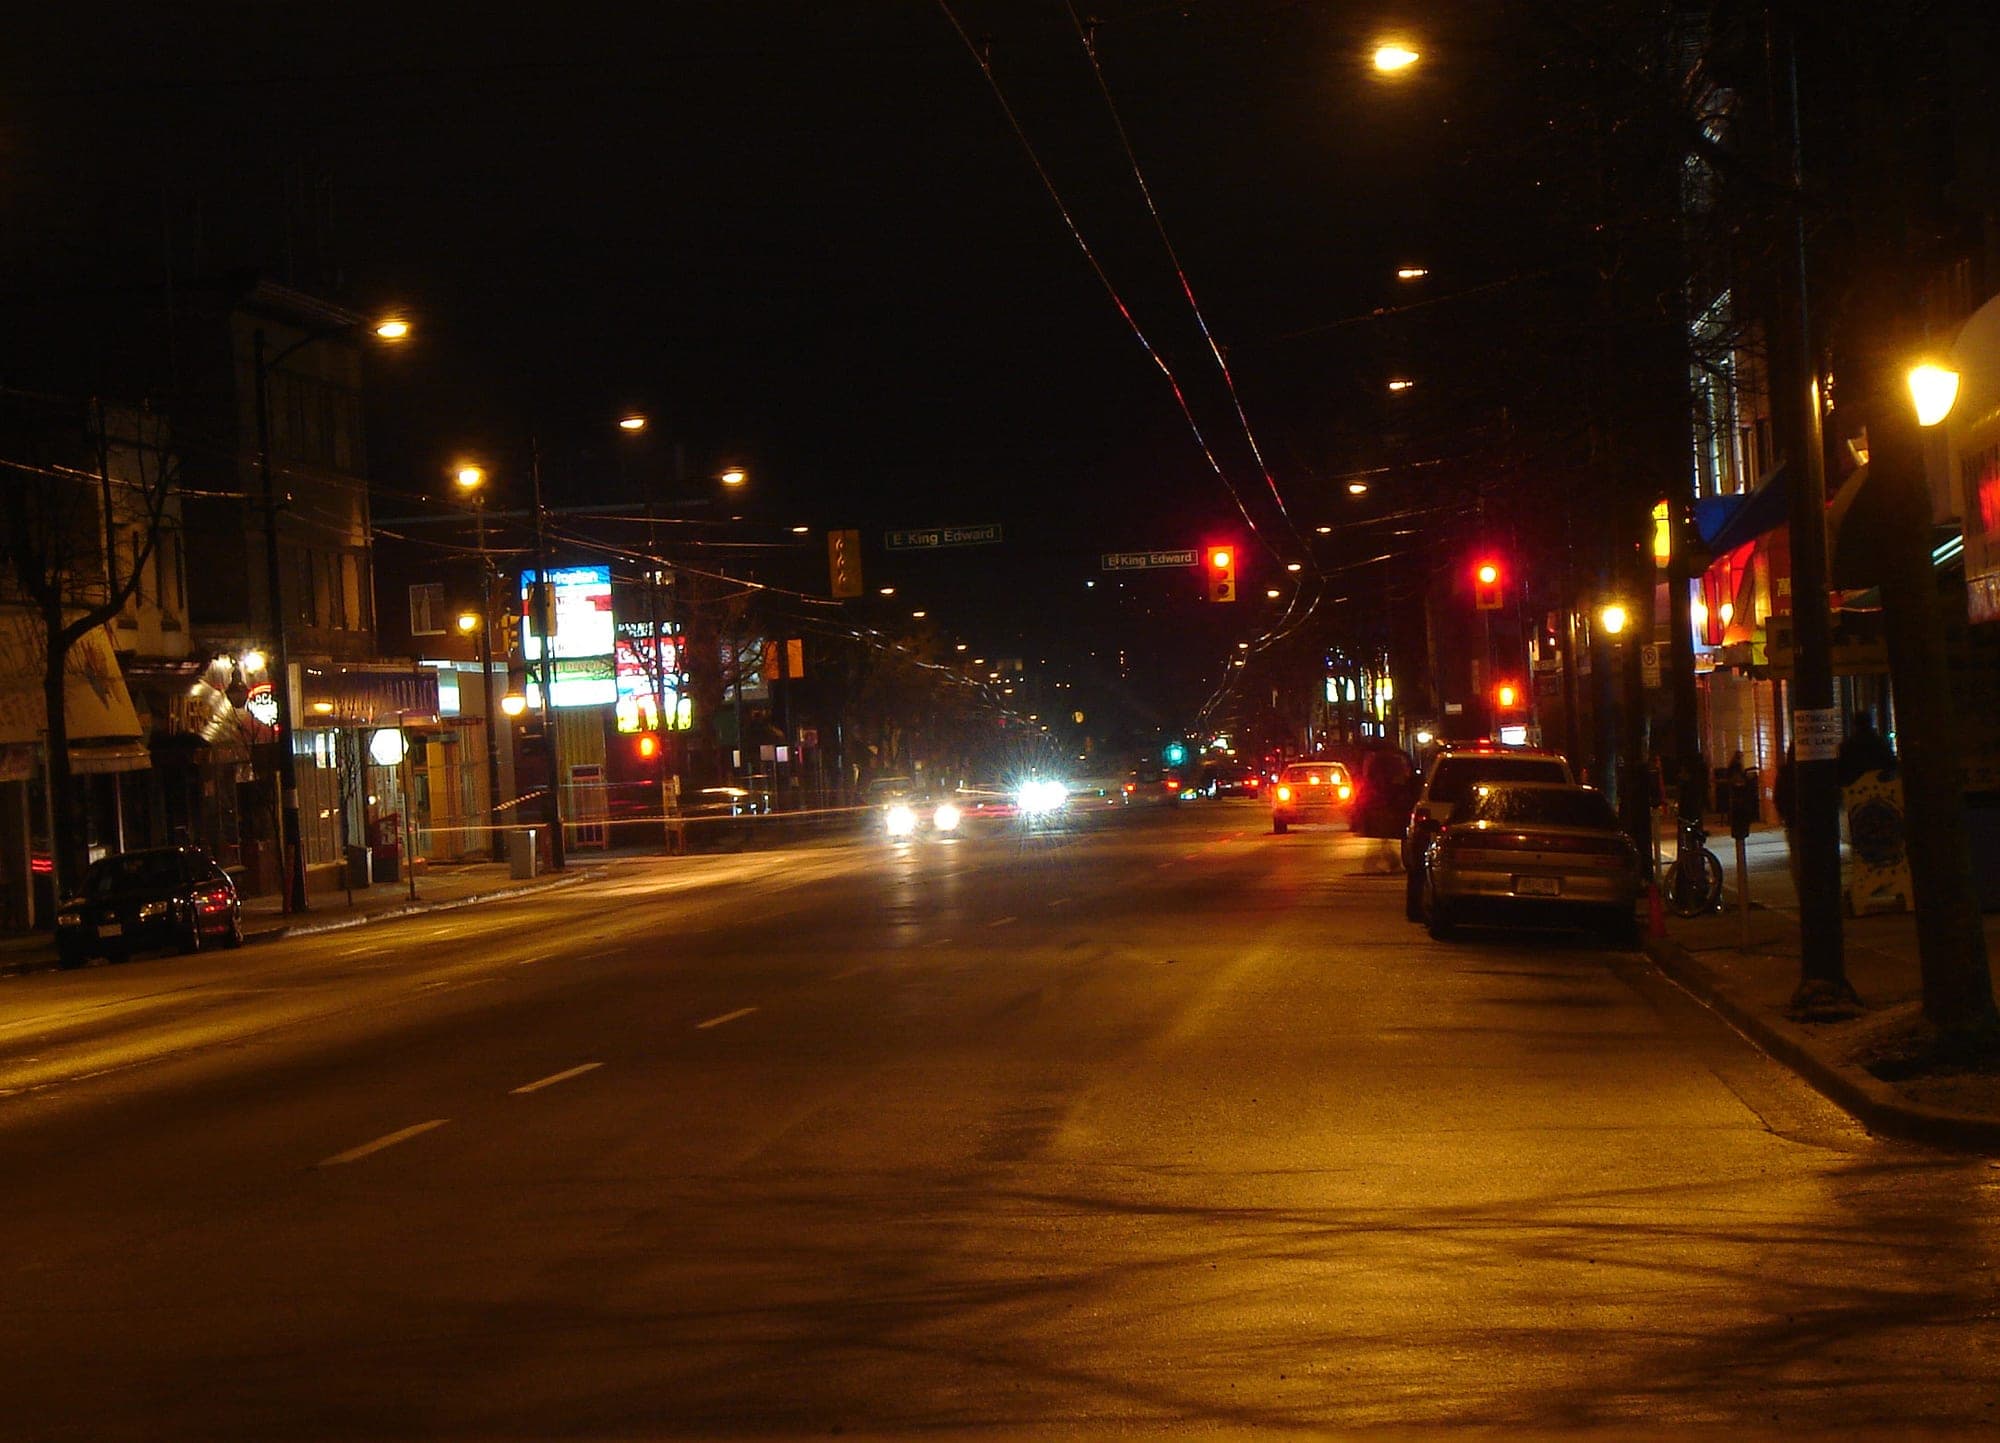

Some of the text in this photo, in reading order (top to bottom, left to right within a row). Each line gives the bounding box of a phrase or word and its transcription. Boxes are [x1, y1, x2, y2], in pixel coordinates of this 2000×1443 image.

[894, 528, 994, 546] E King Edward
[1120, 555, 1146, 567] King
[1150, 552, 1192, 565] Edward
